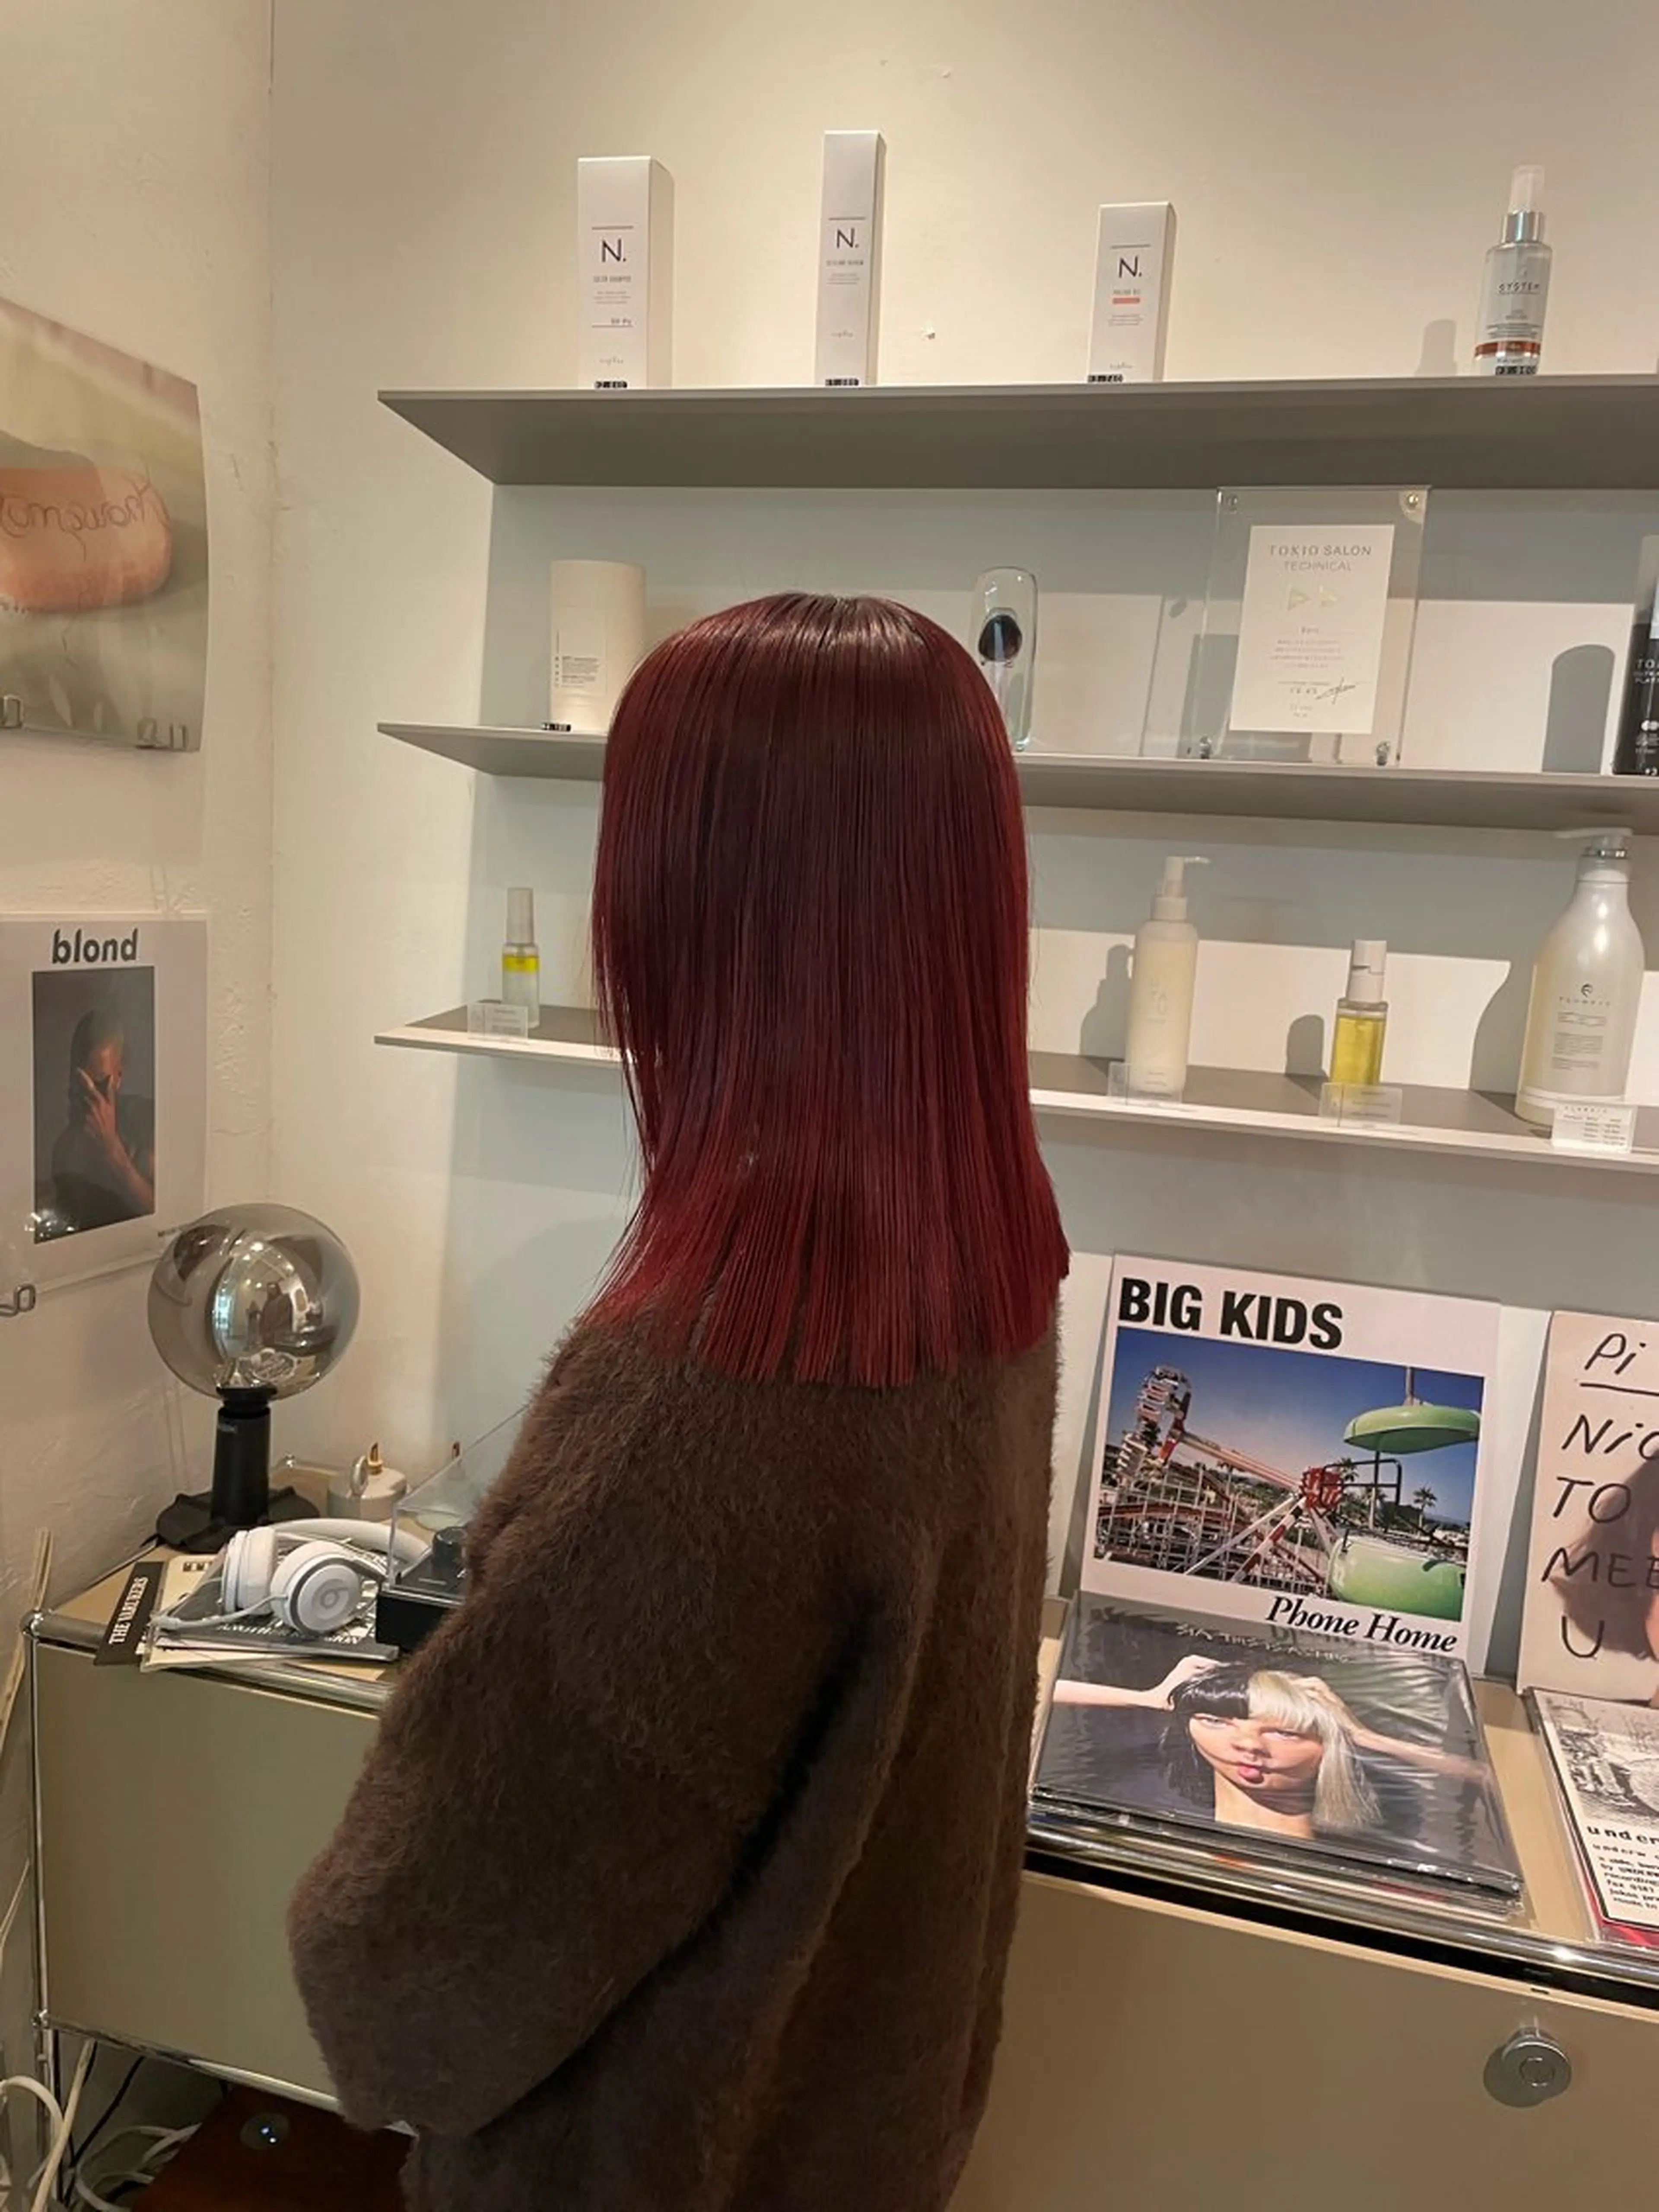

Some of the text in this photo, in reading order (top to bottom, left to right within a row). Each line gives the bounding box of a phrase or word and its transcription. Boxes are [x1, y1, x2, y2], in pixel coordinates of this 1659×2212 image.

[601, 238, 626, 263] N.
[836, 227, 859, 249] N.
[1118, 255, 1142, 278] N.
[1323, 544, 1372, 556] SALON
[1283, 561, 1352, 572] TECHNICAL
[51, 928, 138, 964] blond
[1118, 1277, 1344, 1351] BIG KIDS
[1553, 1476, 1631, 1523] TO
[108, 1622, 131, 1644] THE
[1264, 1594, 1457, 1652] Phone Home
[1561, 1615, 1605, 1658] U
